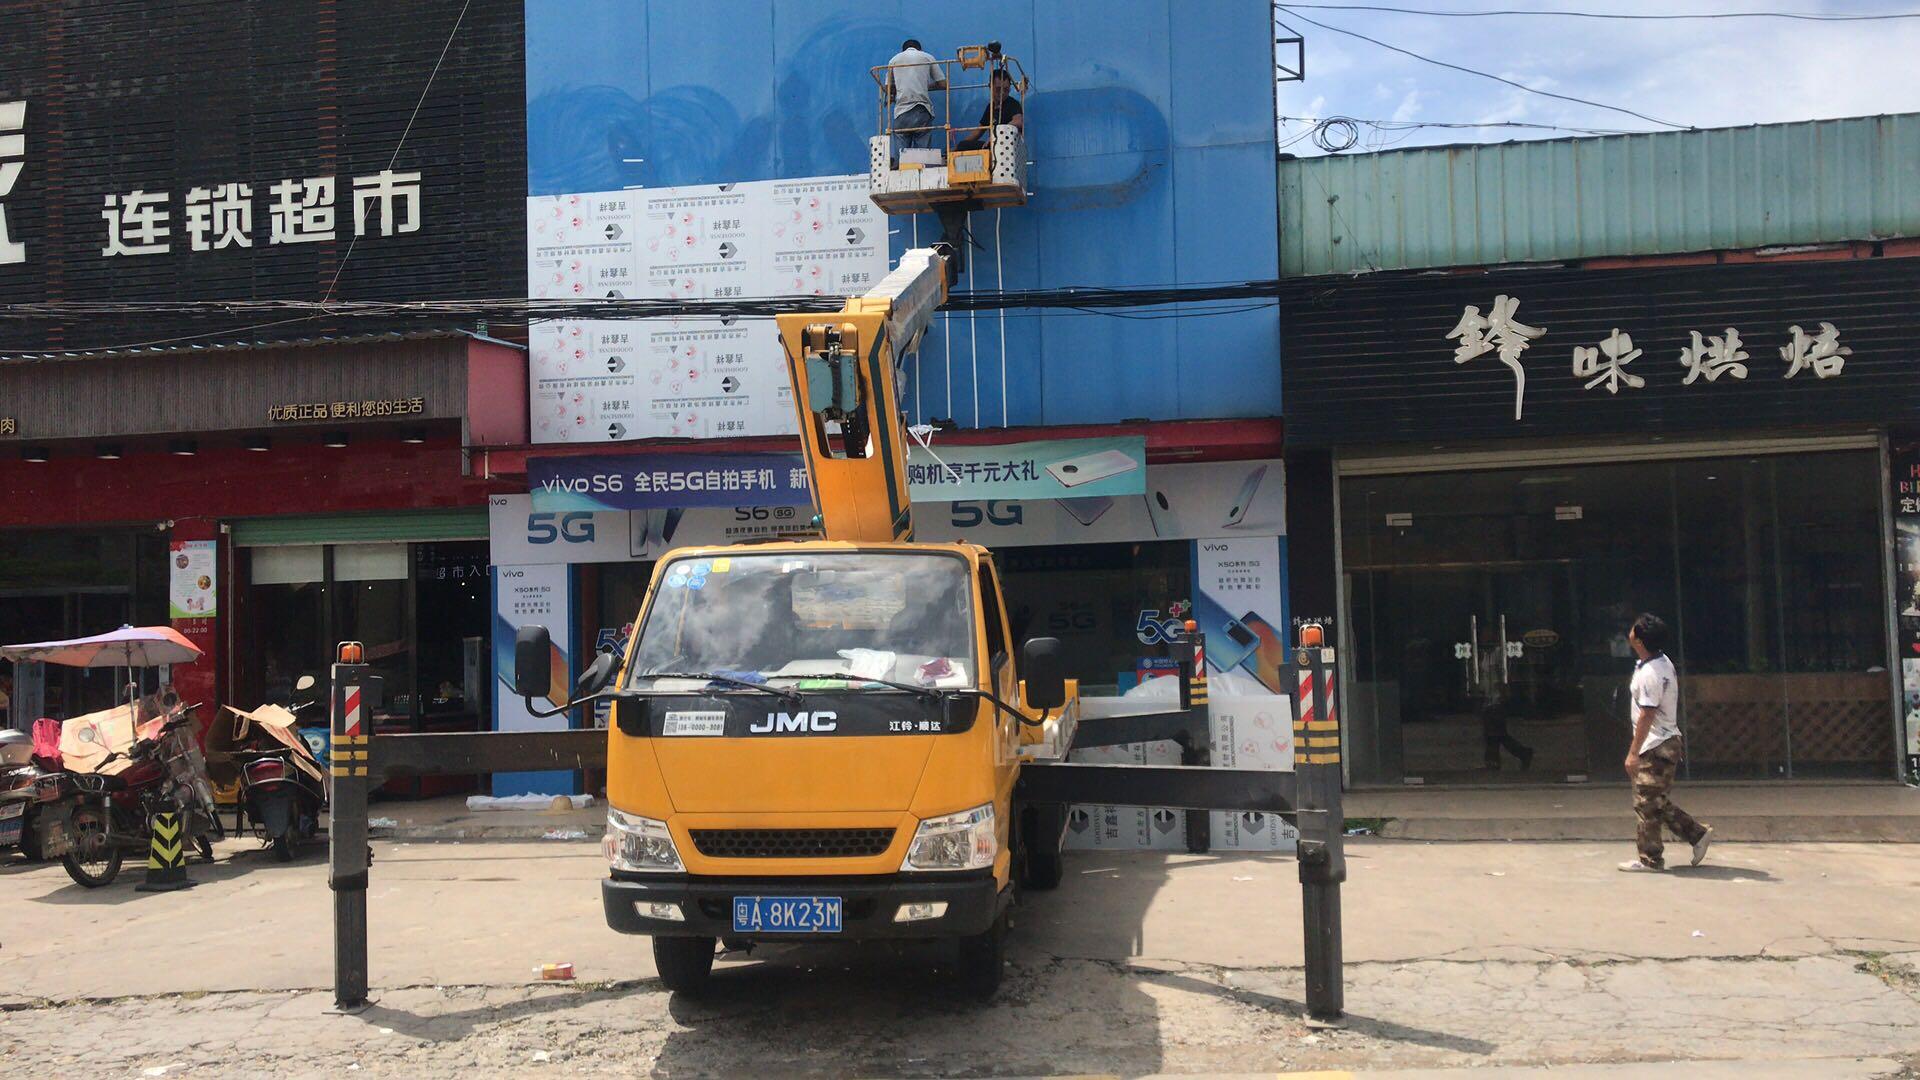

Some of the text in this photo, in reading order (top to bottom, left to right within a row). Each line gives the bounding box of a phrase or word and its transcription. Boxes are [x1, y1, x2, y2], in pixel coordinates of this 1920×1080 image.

[102, 170, 421, 257] 连锁超市
[268, 397, 424, 420] 优质正品 便利您的生活
[0, 417, 15, 434] 肉
[541, 459, 1040, 494] vivo S6 全民5G自拍手机 新 购机享千元大礼
[735, 506, 769, 521] S6
[951, 500, 1022, 528] 5G
[527, 512, 595, 544] 5G
[750, 711, 837, 733] JMC
[737, 902, 839, 927] 粤A·8K23M
